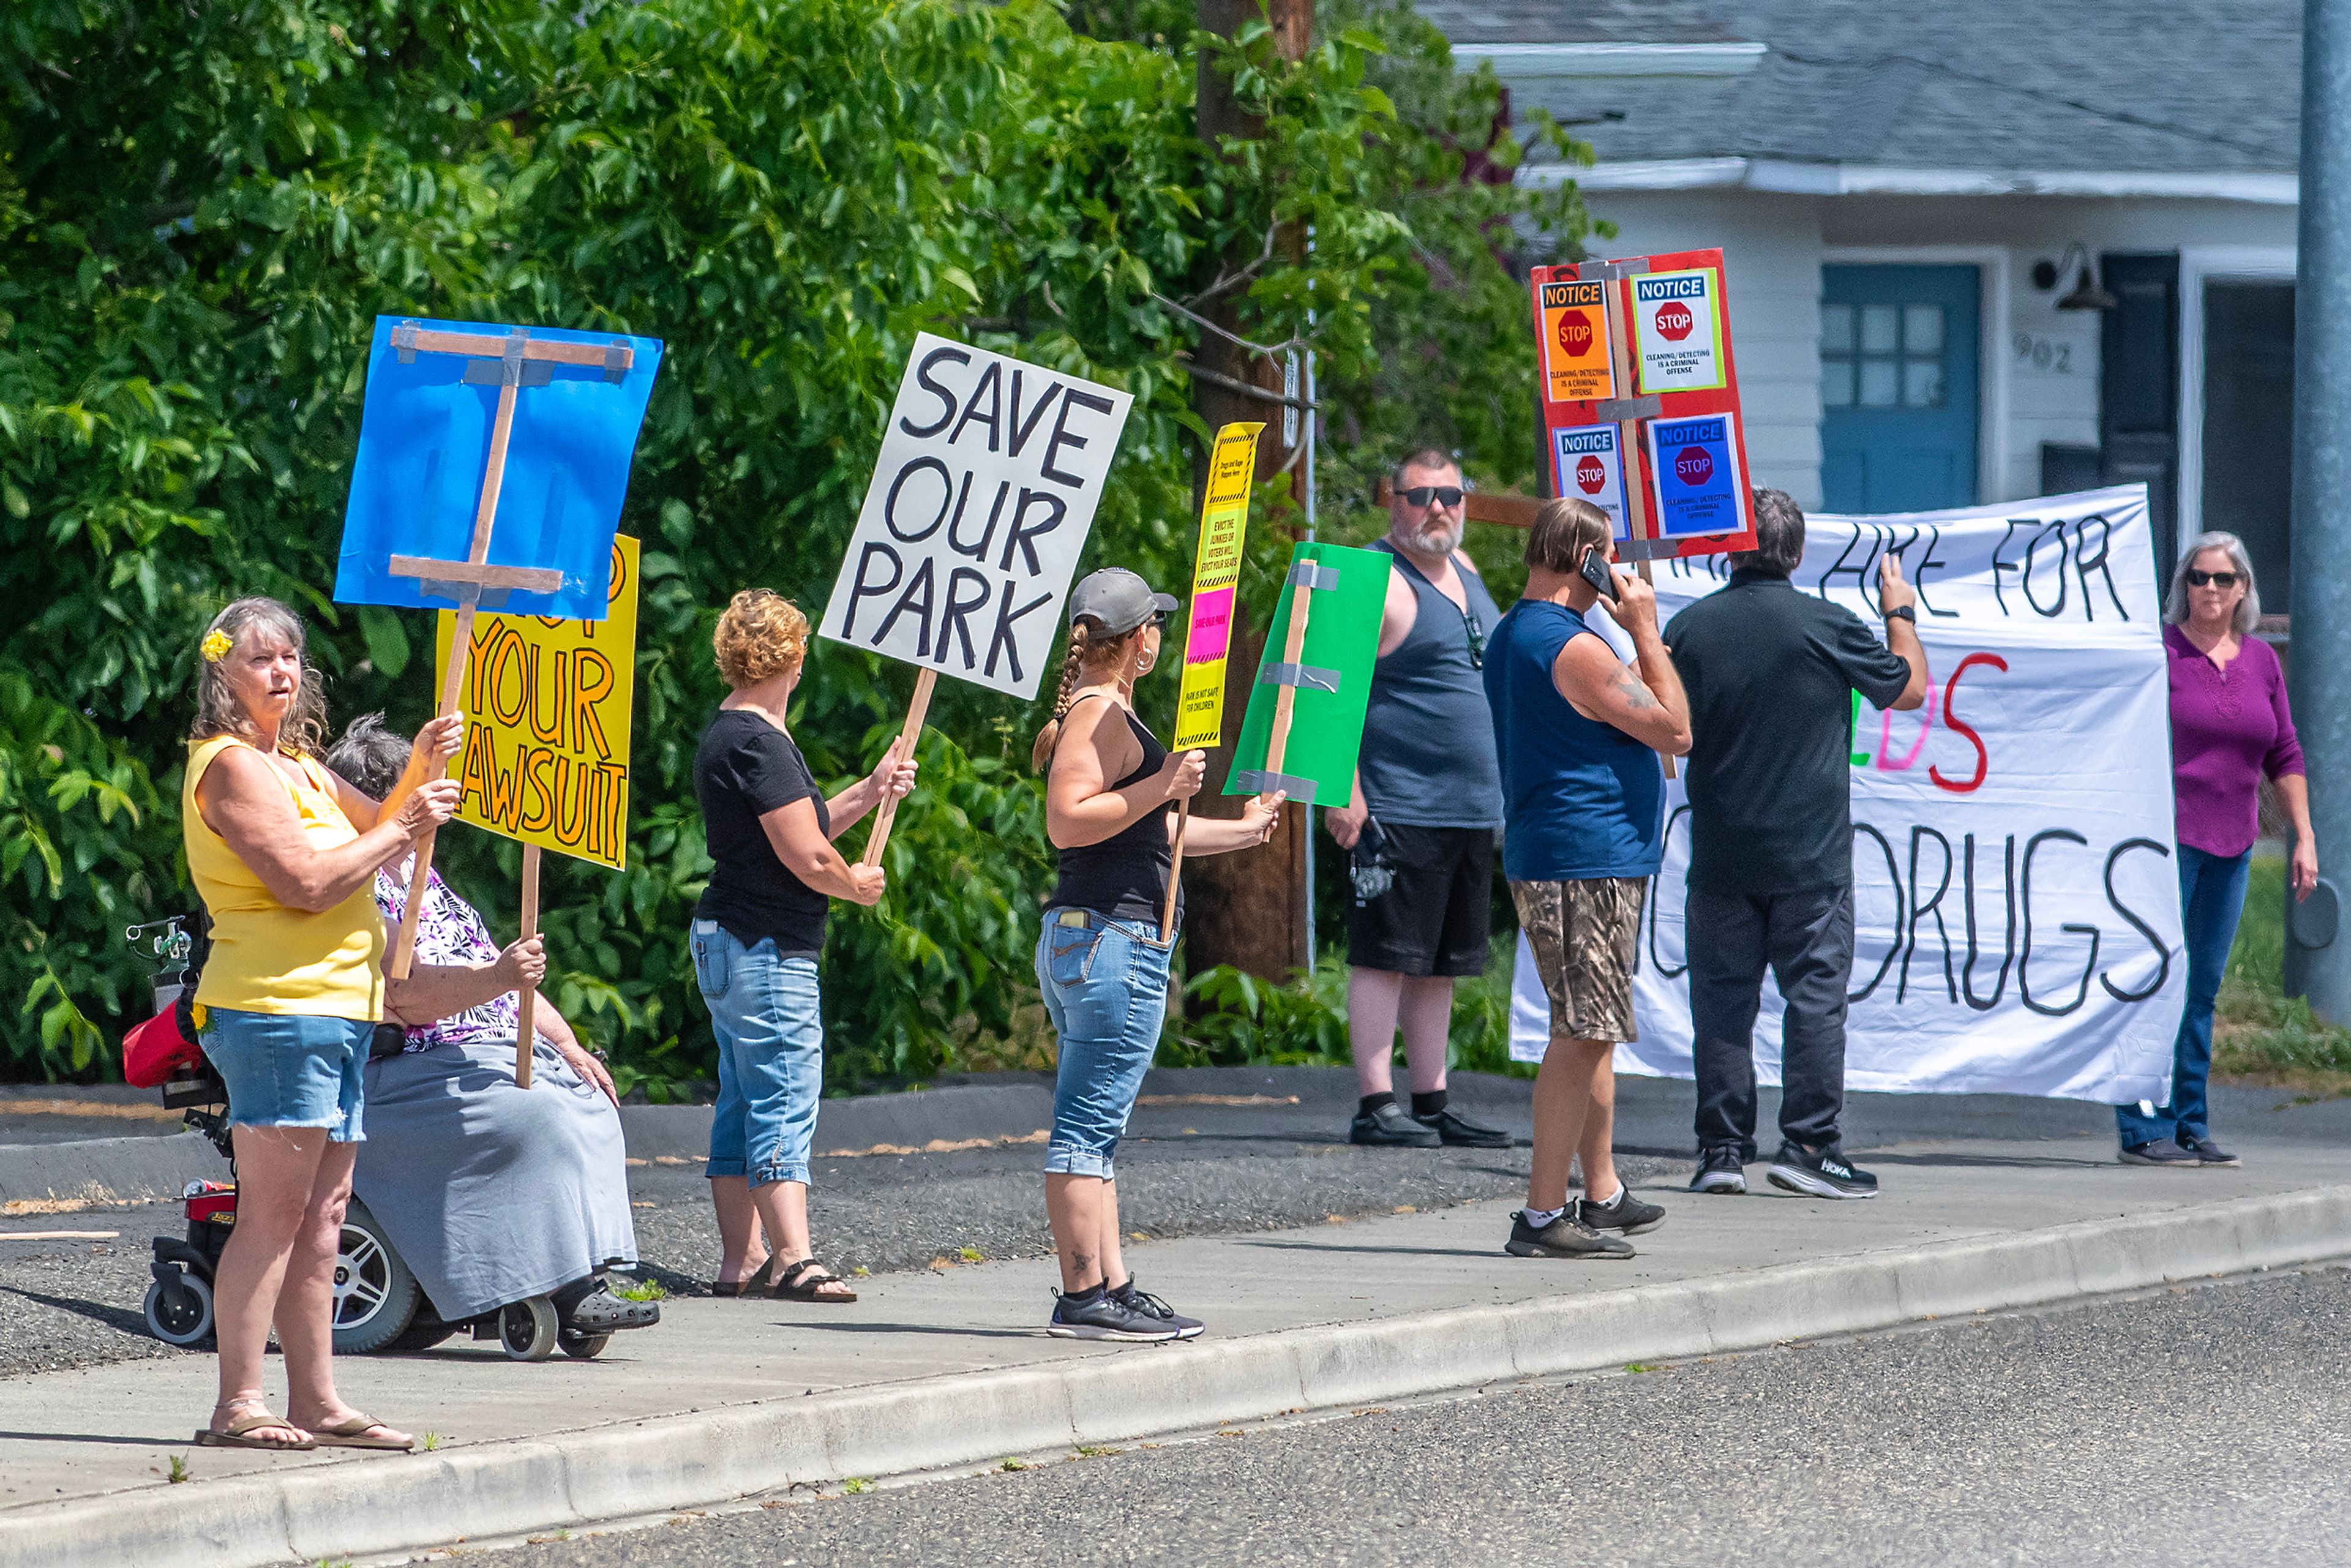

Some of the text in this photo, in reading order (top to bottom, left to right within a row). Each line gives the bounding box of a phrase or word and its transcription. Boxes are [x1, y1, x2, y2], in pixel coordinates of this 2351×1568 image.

[1546, 285, 1600, 306] NOTICE
[1641, 279, 1701, 299] NOTICE
[1657, 313, 1691, 331] STOP
[1560, 325, 1591, 343] STOP
[1670, 358, 1699, 367] CRIMINAL
[2012, 334, 2073, 373] 902
[1666, 366, 1693, 375] OFFENSE
[1572, 378, 1599, 387] CRIMINAL
[1569, 388, 1593, 397] OFFENSE
[899, 347, 1115, 489] SAVE
[1564, 433, 1611, 452] NOTICE
[1662, 422, 1720, 445] NOTICE
[1677, 458, 1710, 475] STOP
[1578, 468, 1604, 484] STOP
[885, 456, 1067, 577] OUR
[1687, 511, 1714, 520] OFFENSE
[1691, 503, 1720, 512] CRIMINAL
[1214, 520, 1227, 531] EVICT
[1210, 532, 1235, 545] JUNKIES OR
[1208, 545, 1234, 558] VOTERS WILL
[1201, 557, 1238, 573] EVICT YOUR SEATS
[1992, 514, 2130, 622] FOR
[841, 541, 1053, 683] PARK
[469, 617, 615, 762] YOUR
[1186, 691, 1195, 702] PARK
[1207, 686, 1219, 697] SAFE
[1193, 700, 1214, 712] CHILDREN
[438, 702, 627, 865] AWSUIT
[1847, 822, 2170, 1017] DRUGS
[1820, 1157, 1852, 1179] HOKA
